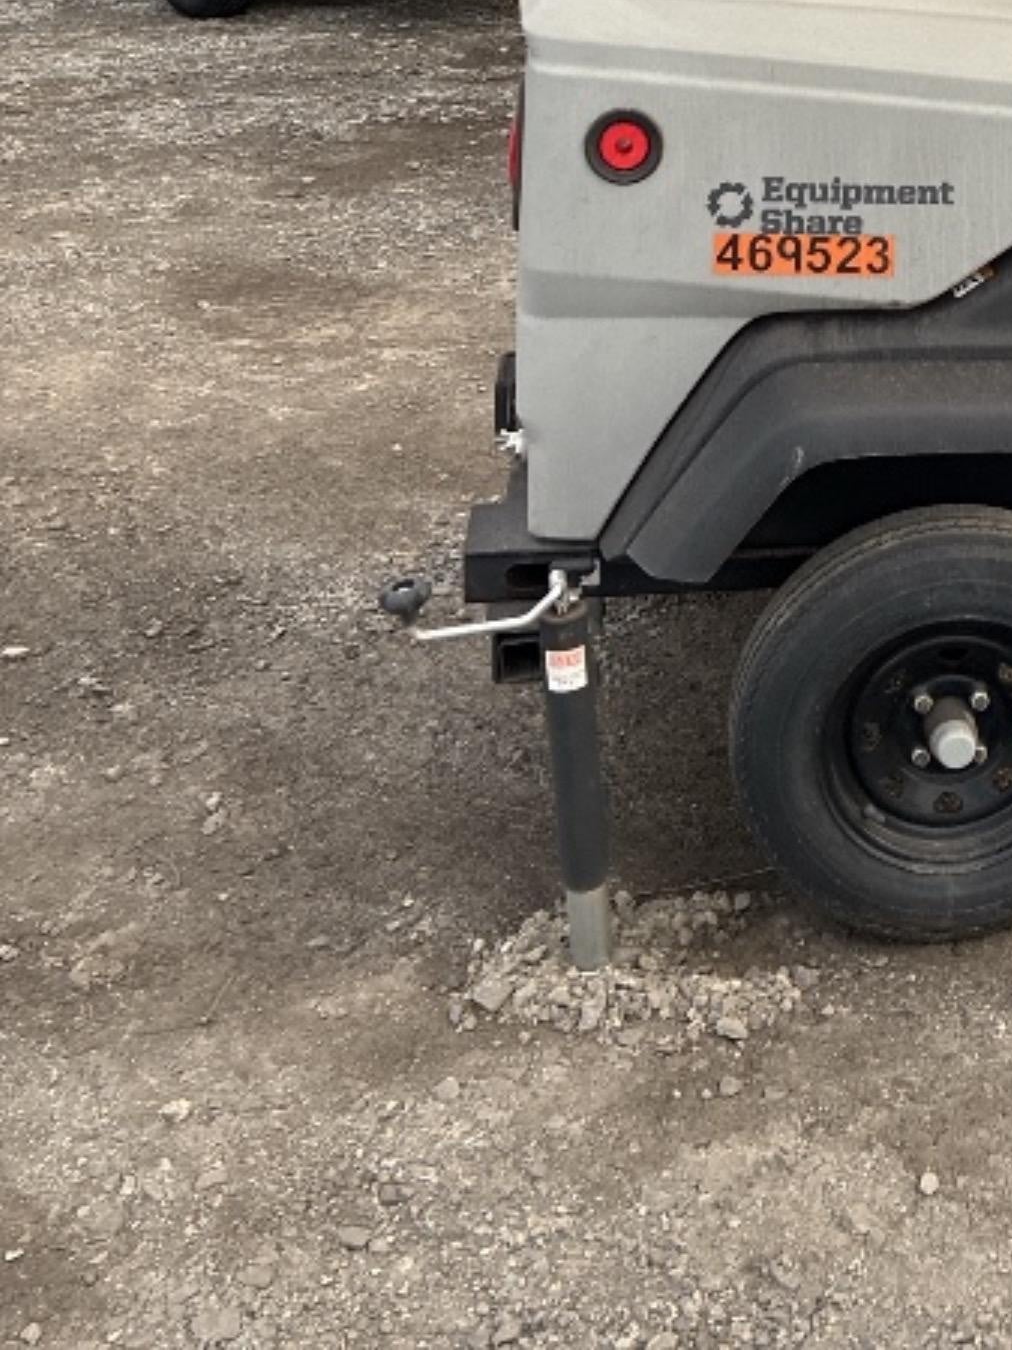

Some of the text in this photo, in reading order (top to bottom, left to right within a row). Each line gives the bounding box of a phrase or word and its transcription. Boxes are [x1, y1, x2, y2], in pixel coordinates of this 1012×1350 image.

[761, 176, 955, 210] Equipment
[761, 209, 863, 235] Share
[715, 234, 890, 275] 469523
